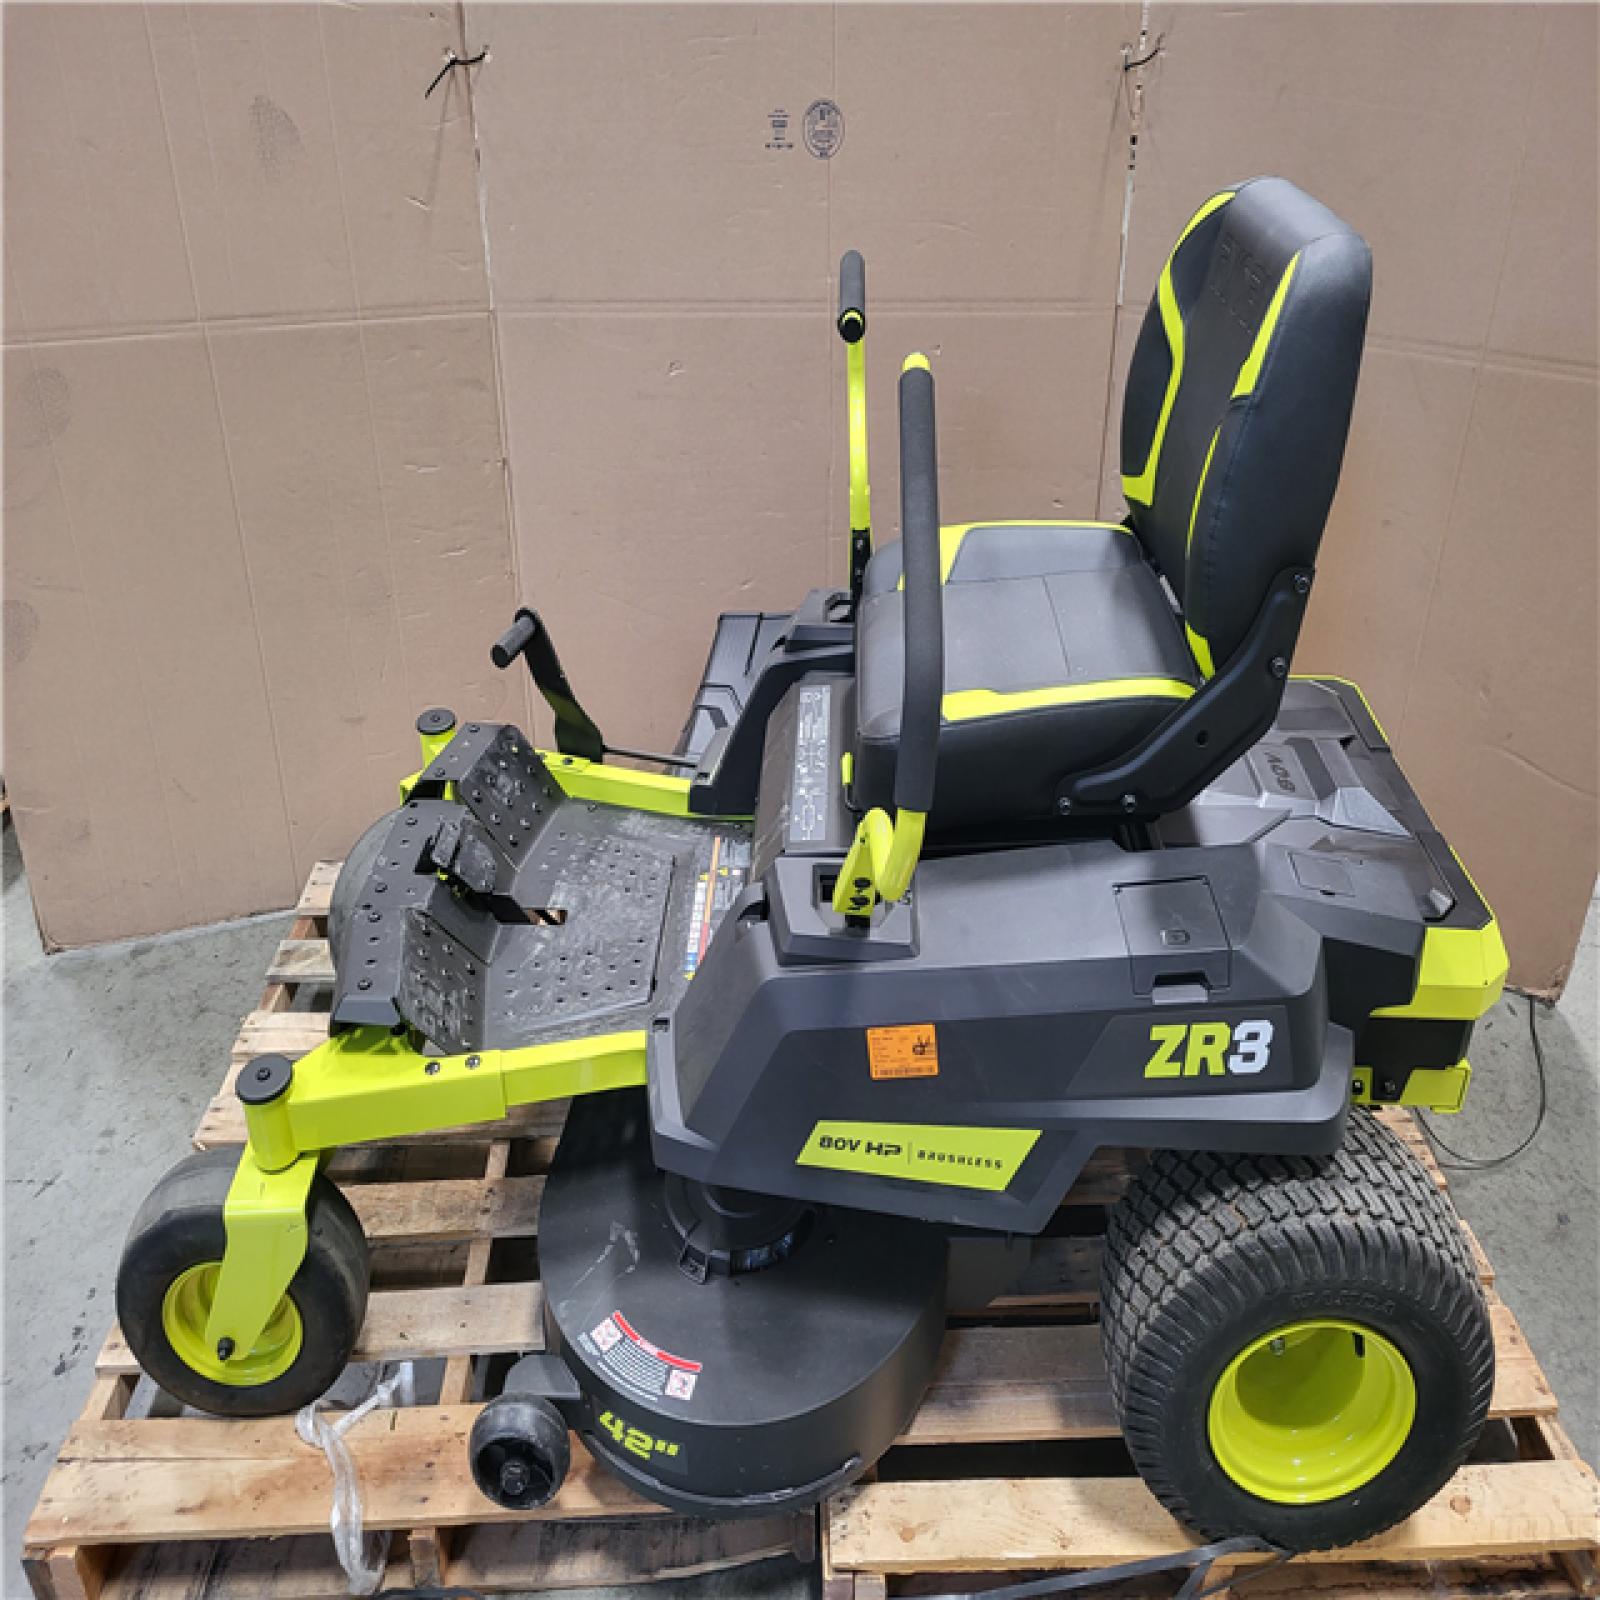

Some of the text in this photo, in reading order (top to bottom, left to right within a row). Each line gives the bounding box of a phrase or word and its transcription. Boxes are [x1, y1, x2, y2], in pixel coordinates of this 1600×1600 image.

[1143, 1019, 1275, 1079] ZR3
[818, 1134, 903, 1156] 80V HP
[599, 1411, 680, 1460] 42"
